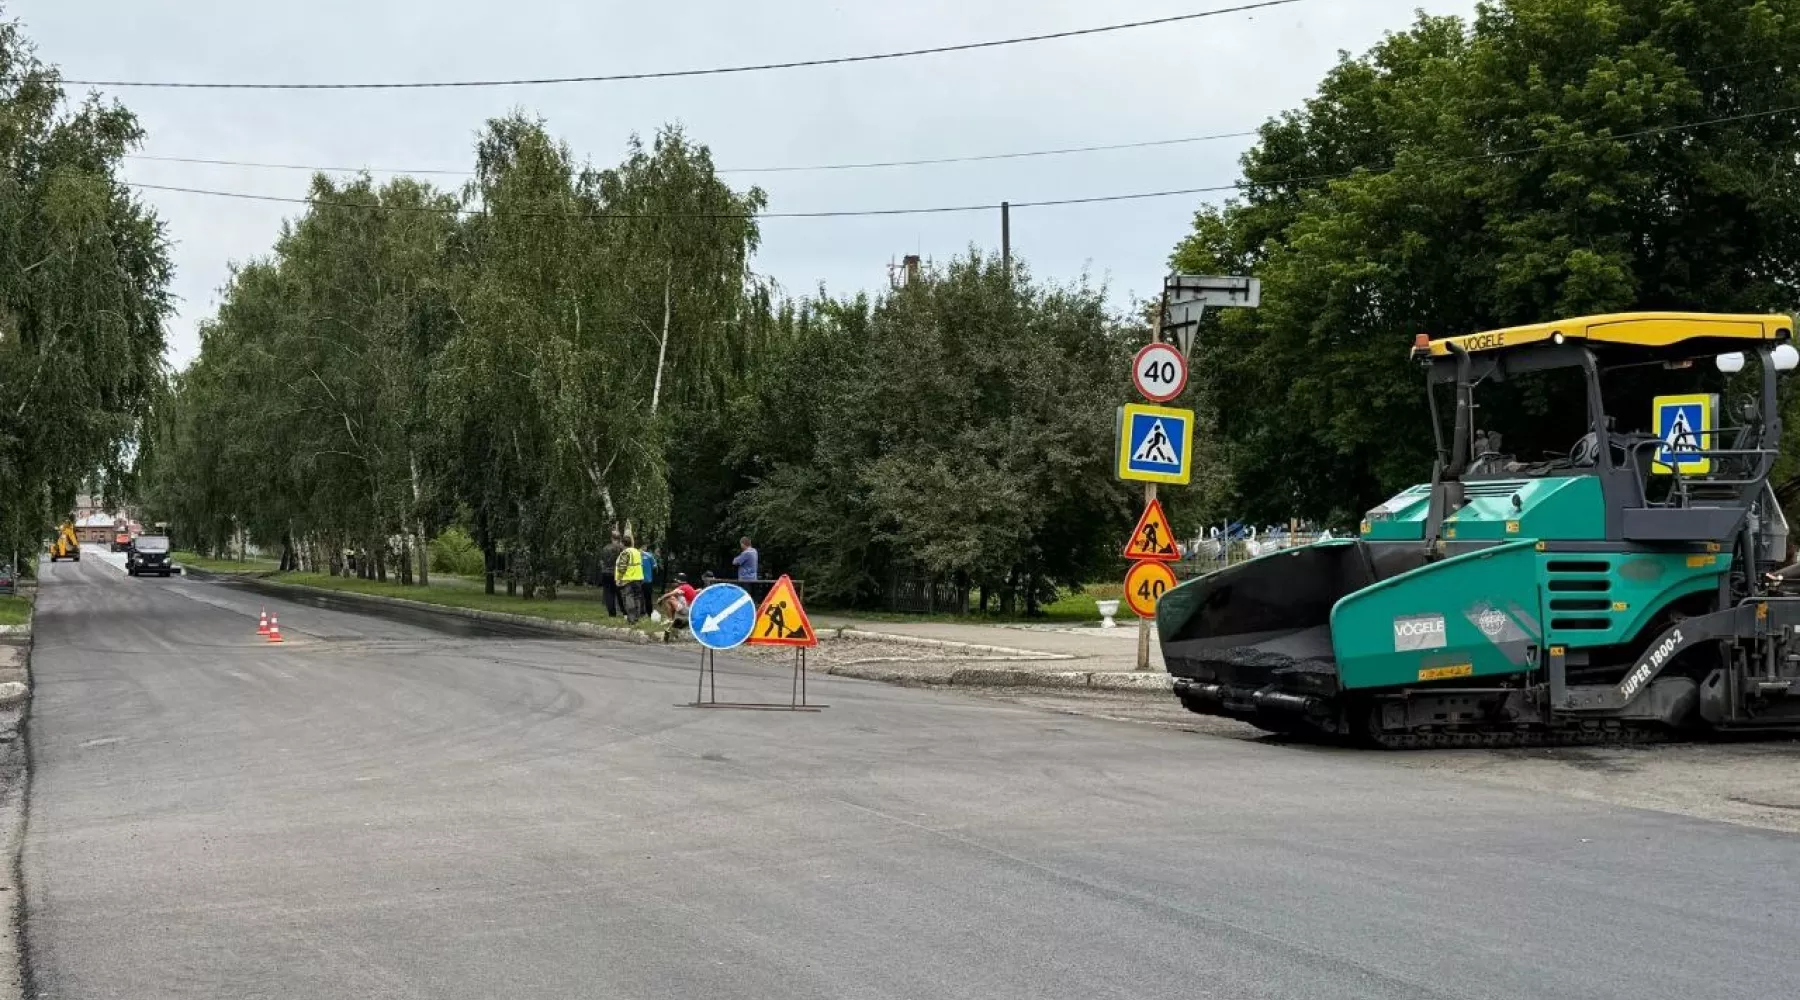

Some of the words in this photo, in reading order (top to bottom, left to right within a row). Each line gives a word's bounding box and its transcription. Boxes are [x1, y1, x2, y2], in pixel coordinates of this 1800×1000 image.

[1144, 361, 1175, 384] 40
[1137, 579, 1165, 600] 40
[1621, 663, 1652, 700] SUPER
[1649, 628, 1684, 668] 1800-2
